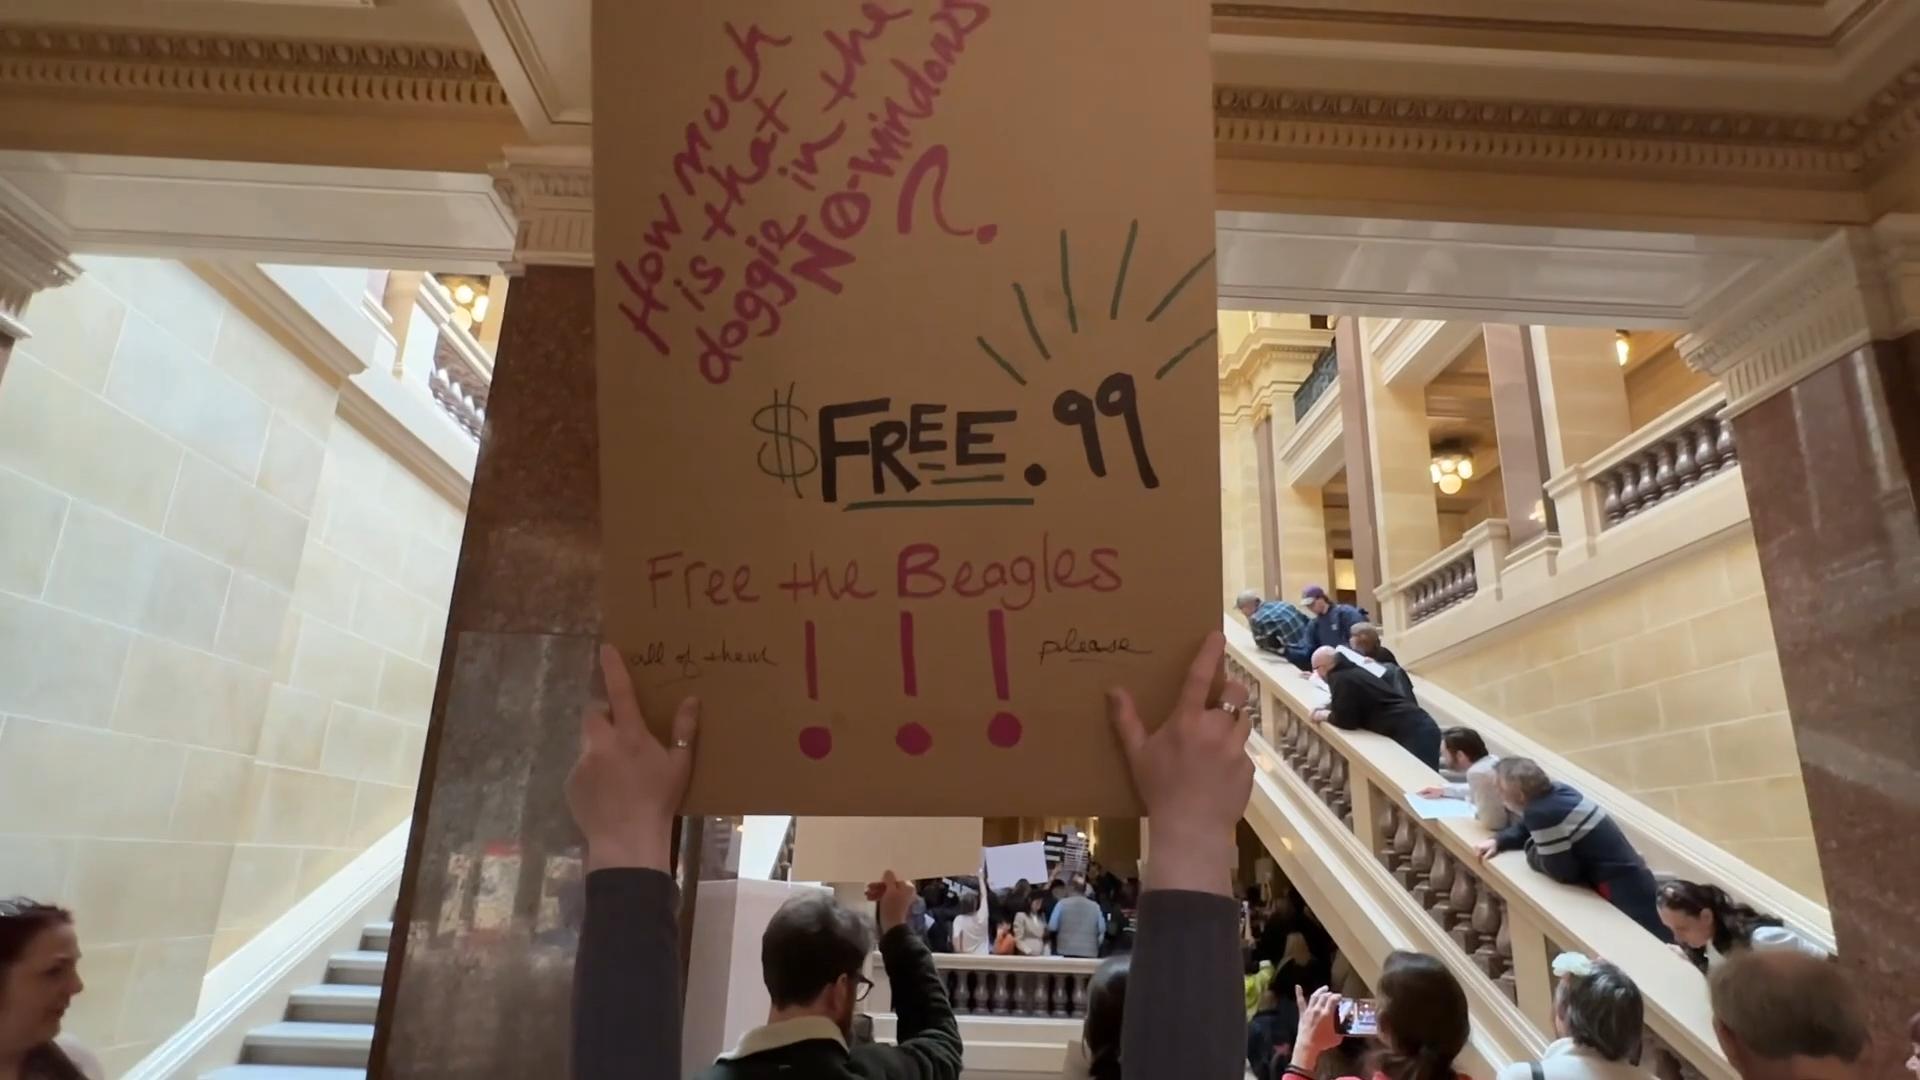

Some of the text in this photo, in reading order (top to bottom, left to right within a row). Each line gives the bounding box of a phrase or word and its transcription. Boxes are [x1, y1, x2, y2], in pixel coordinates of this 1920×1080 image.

[617, 21, 792, 356] How much
[674, 90, 789, 311] is that
[697, 1, 913, 384] doggie in the
[646, 531, 1124, 611] Free the Beagles
[1038, 628, 1153, 664] please
[629, 641, 666, 667] all
